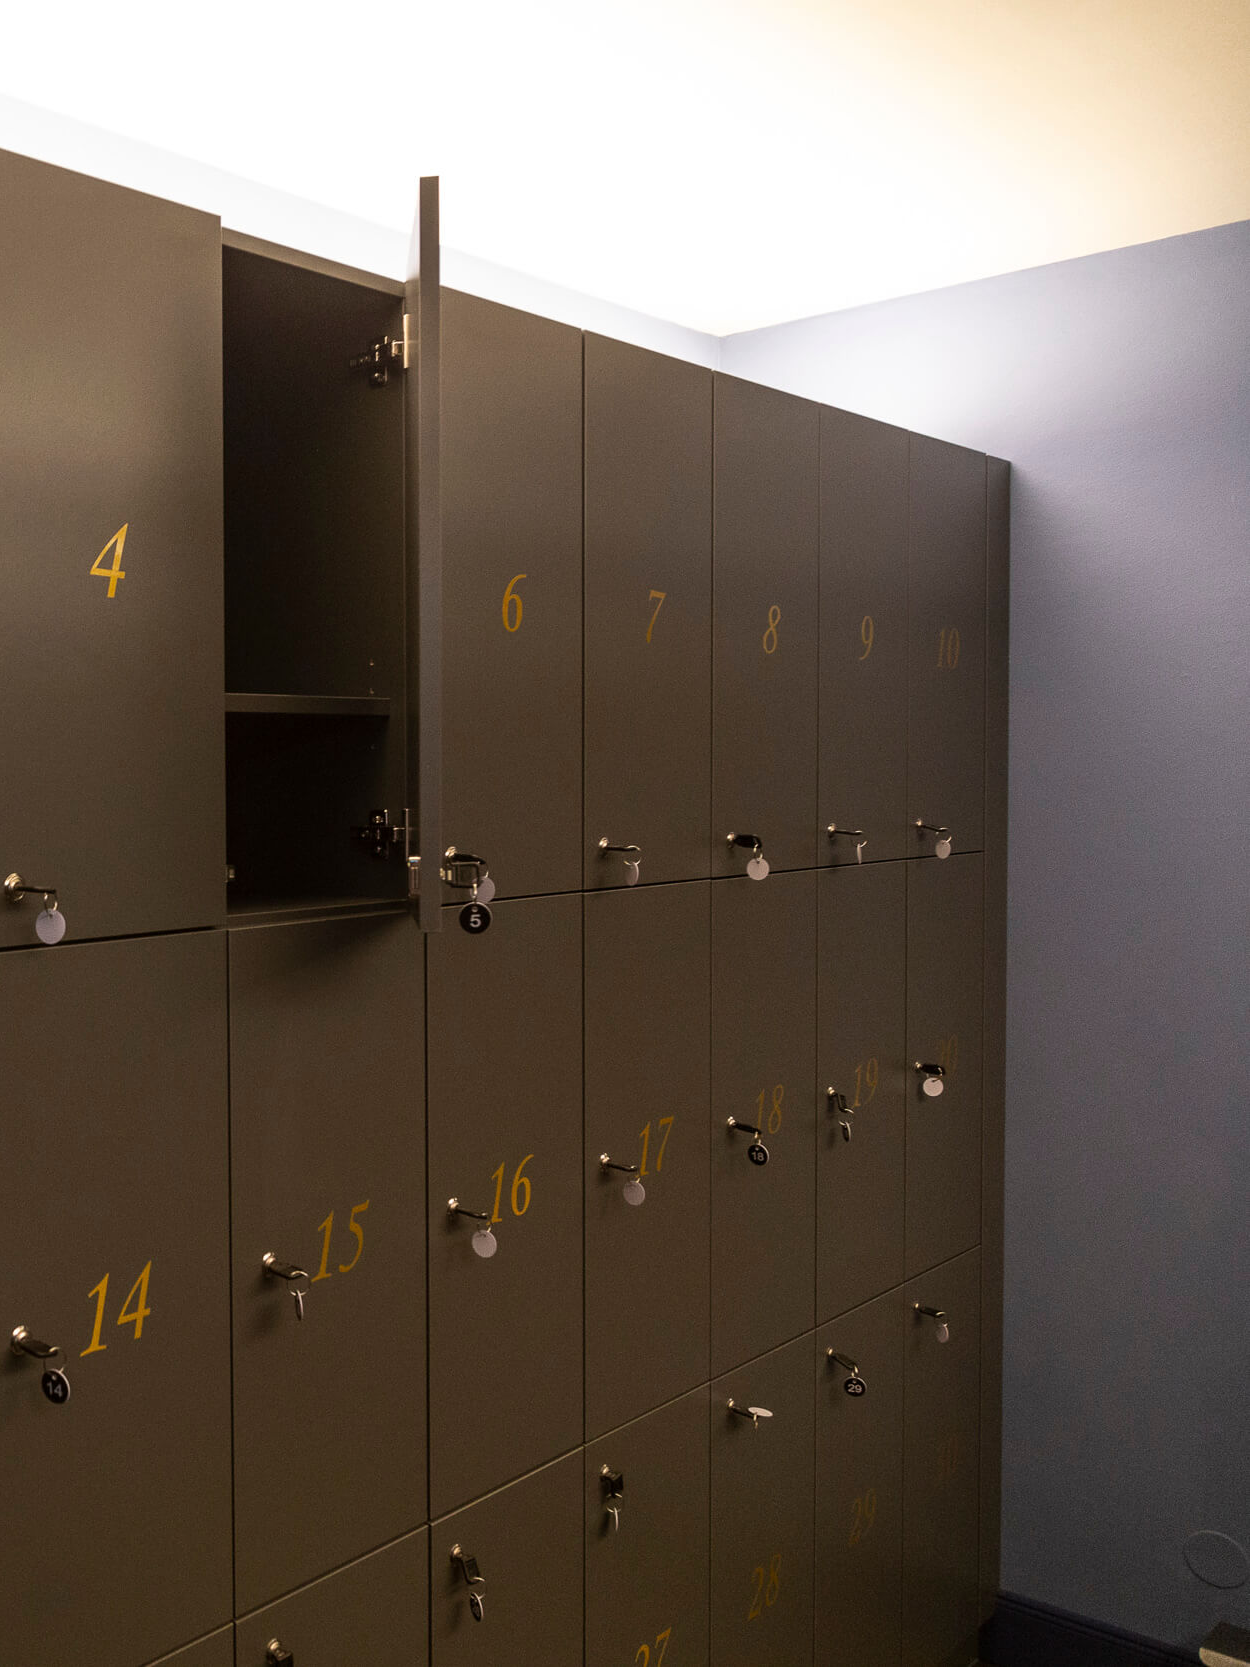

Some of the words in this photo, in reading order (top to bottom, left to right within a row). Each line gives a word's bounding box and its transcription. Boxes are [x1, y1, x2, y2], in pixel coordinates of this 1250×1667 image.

[89, 523, 128, 600] 4
[501, 572, 527, 634] 6
[645, 588, 667, 645] 7
[761, 604, 782, 656] 8
[859, 615, 876, 661] 9
[936, 627, 961, 669] 10
[469, 913, 482, 929] 5
[753, 1083, 785, 1140] 18
[851, 1057, 880, 1109] 19
[639, 1114, 675, 1178] 17
[490, 1153, 535, 1225] 16
[311, 1199, 371, 1283] 15
[80, 1260, 153, 1358] 14
[747, 1552, 783, 1622] 28
